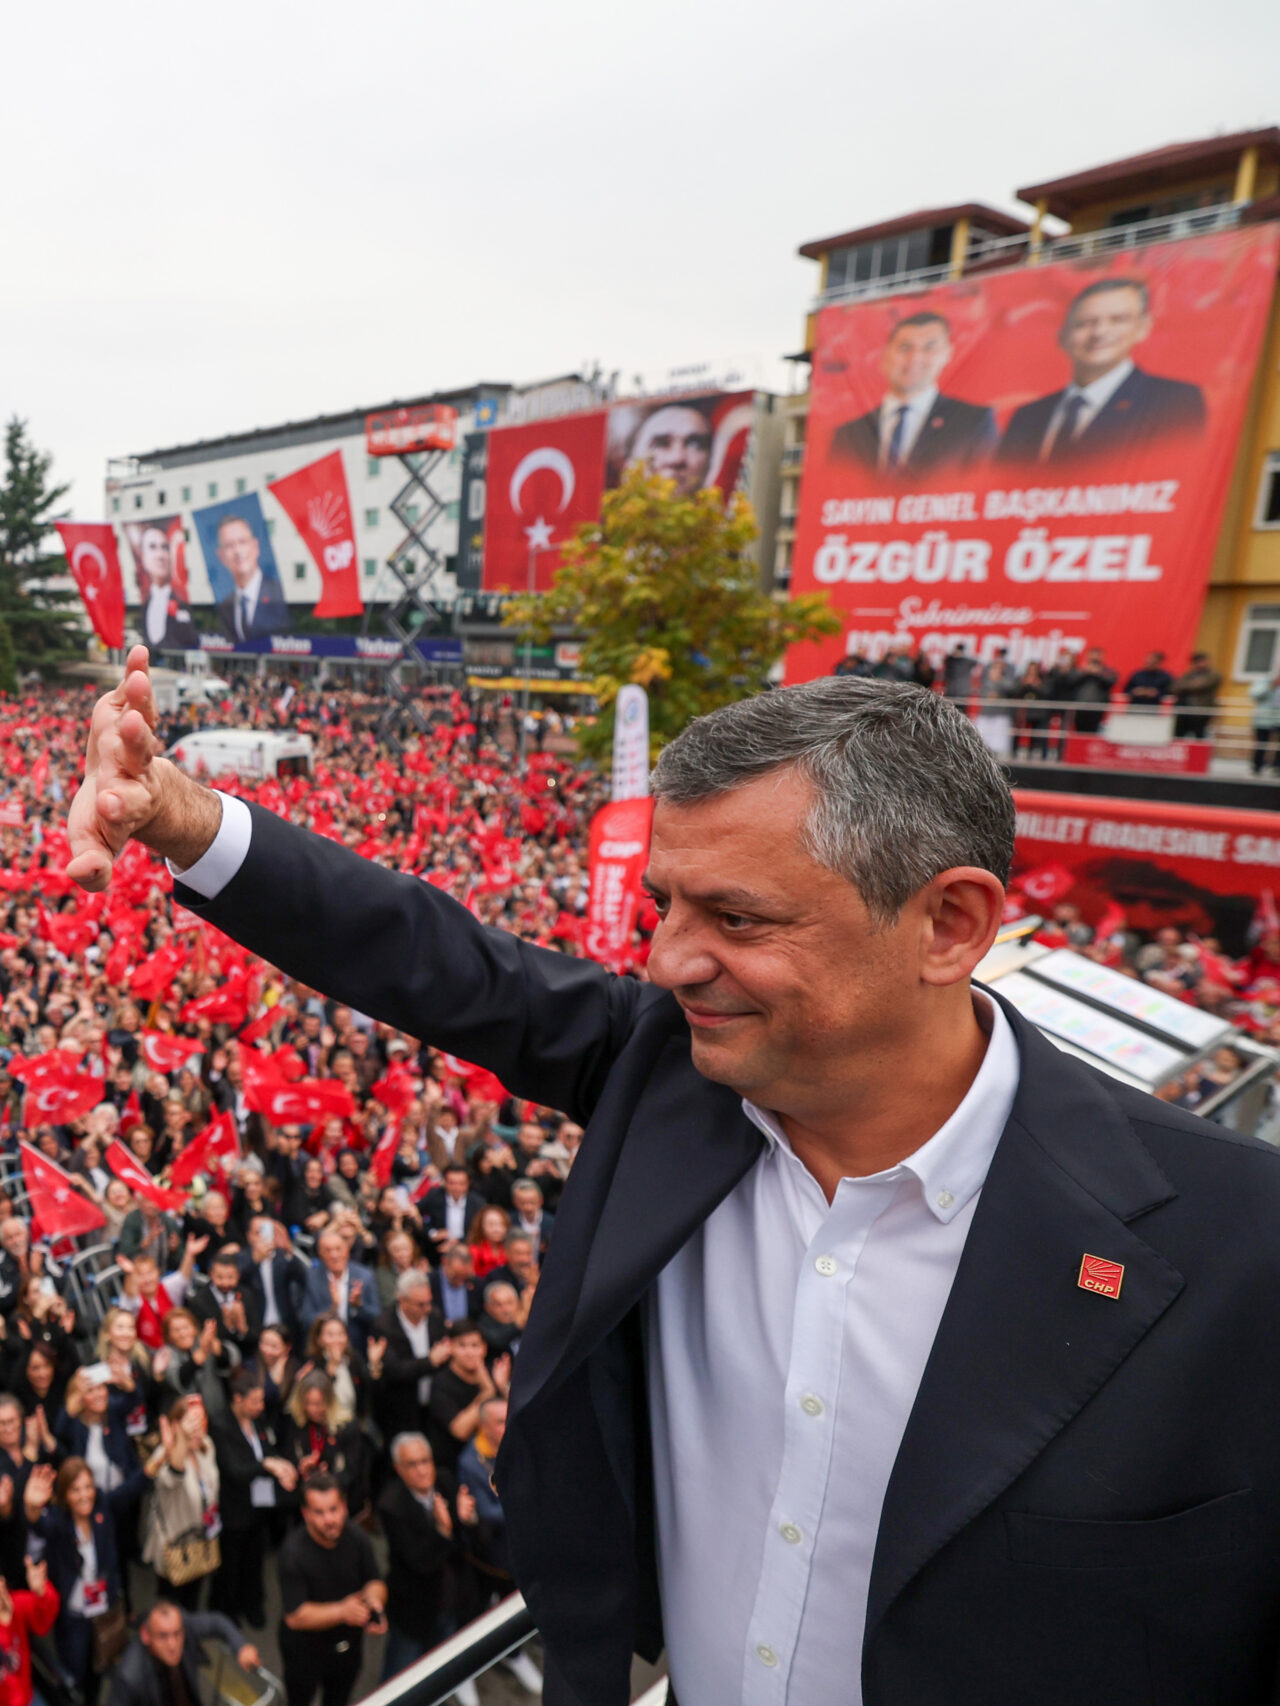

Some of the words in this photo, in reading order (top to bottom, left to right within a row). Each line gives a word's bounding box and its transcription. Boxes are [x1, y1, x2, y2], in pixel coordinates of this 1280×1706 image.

[821, 497, 895, 526] SAYIN
[897, 492, 980, 524] GENEL
[983, 481, 1178, 522] BAŞKANIMIZ
[813, 530, 992, 583] ÖZGÜR
[1004, 527, 1162, 583] ÖZEL
[1084, 1279, 1114, 1293] CHP
